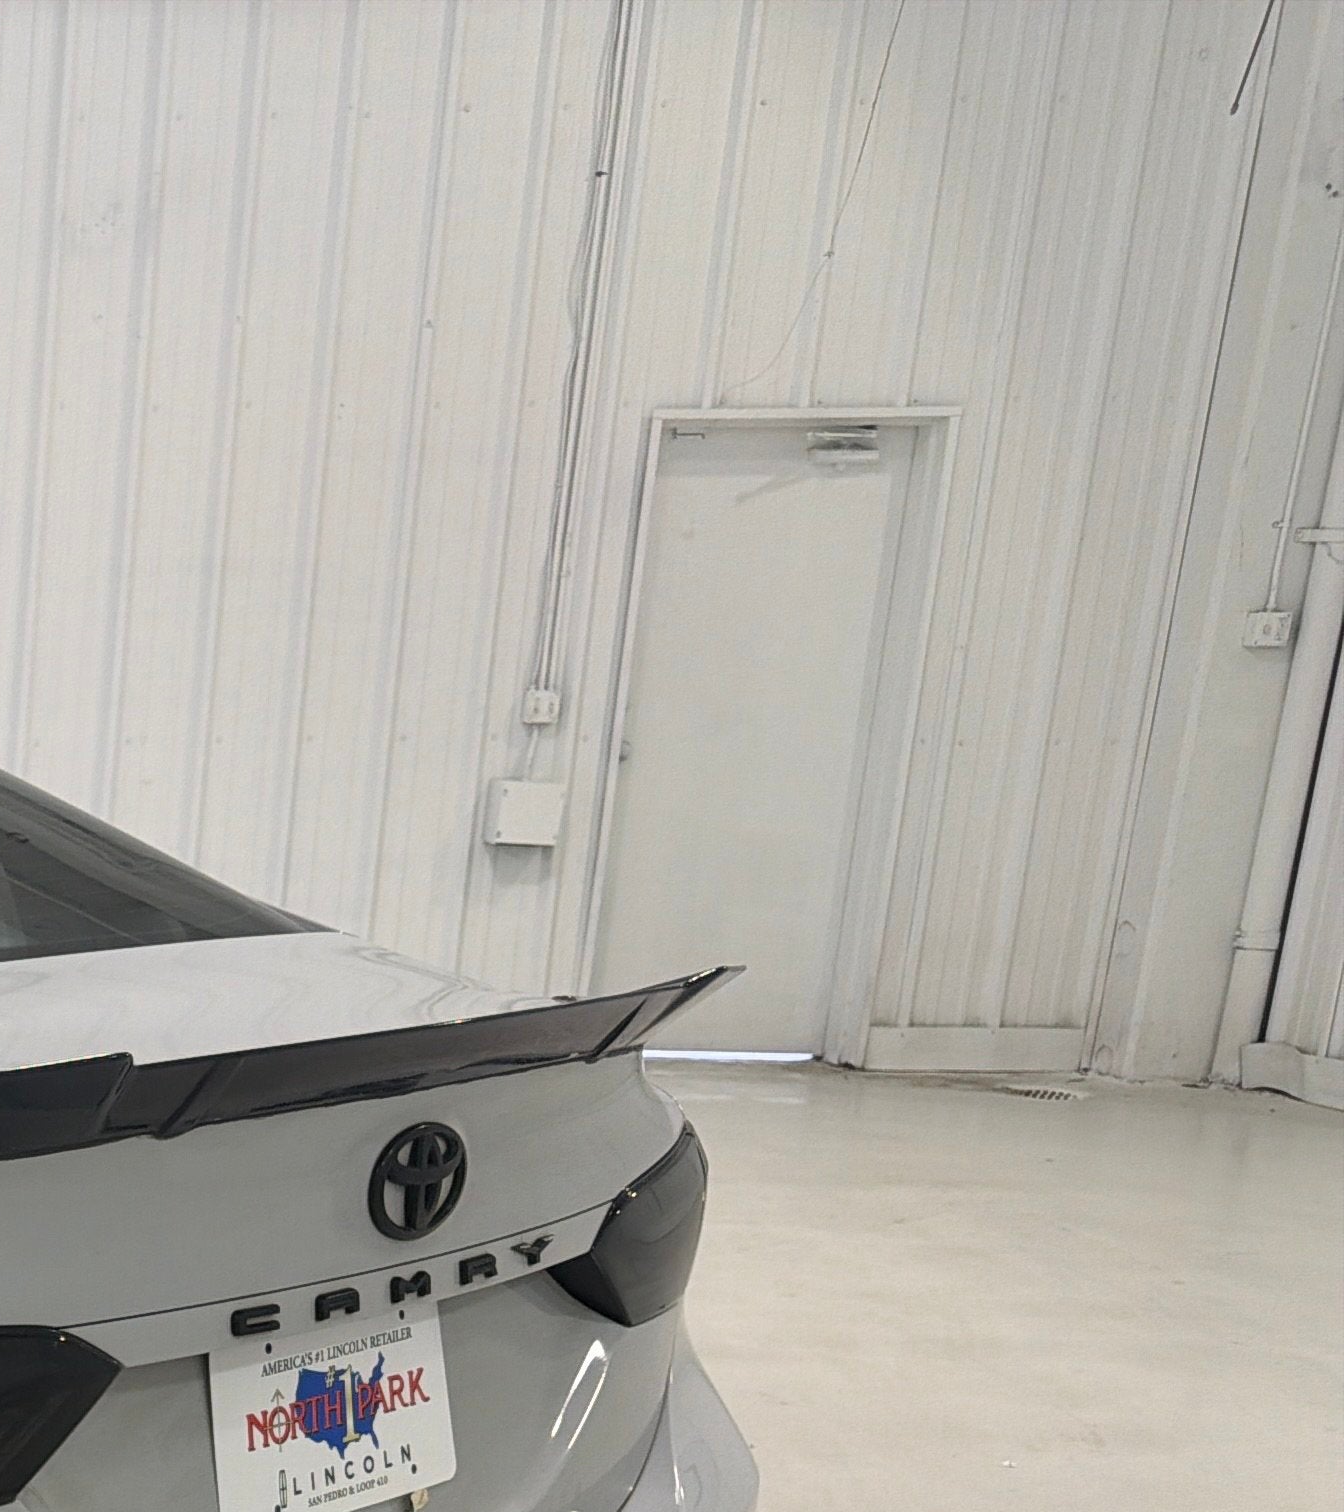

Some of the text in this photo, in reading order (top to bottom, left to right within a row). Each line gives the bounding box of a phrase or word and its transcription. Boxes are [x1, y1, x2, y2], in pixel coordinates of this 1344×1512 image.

[230, 1233, 554, 1337] CAMRY
[261, 1326, 413, 1377] AMERICA'S #1 LINCOLN RETAILER
[245, 1367, 431, 1452] NORTH PARK
[292, 1443, 412, 1496] LINCOLN
[307, 1494, 323, 1508] SAN
[323, 1487, 348, 1504] PEDRO
[356, 1479, 377, 1494] LOOP
[376, 1475, 389, 1488] 410
